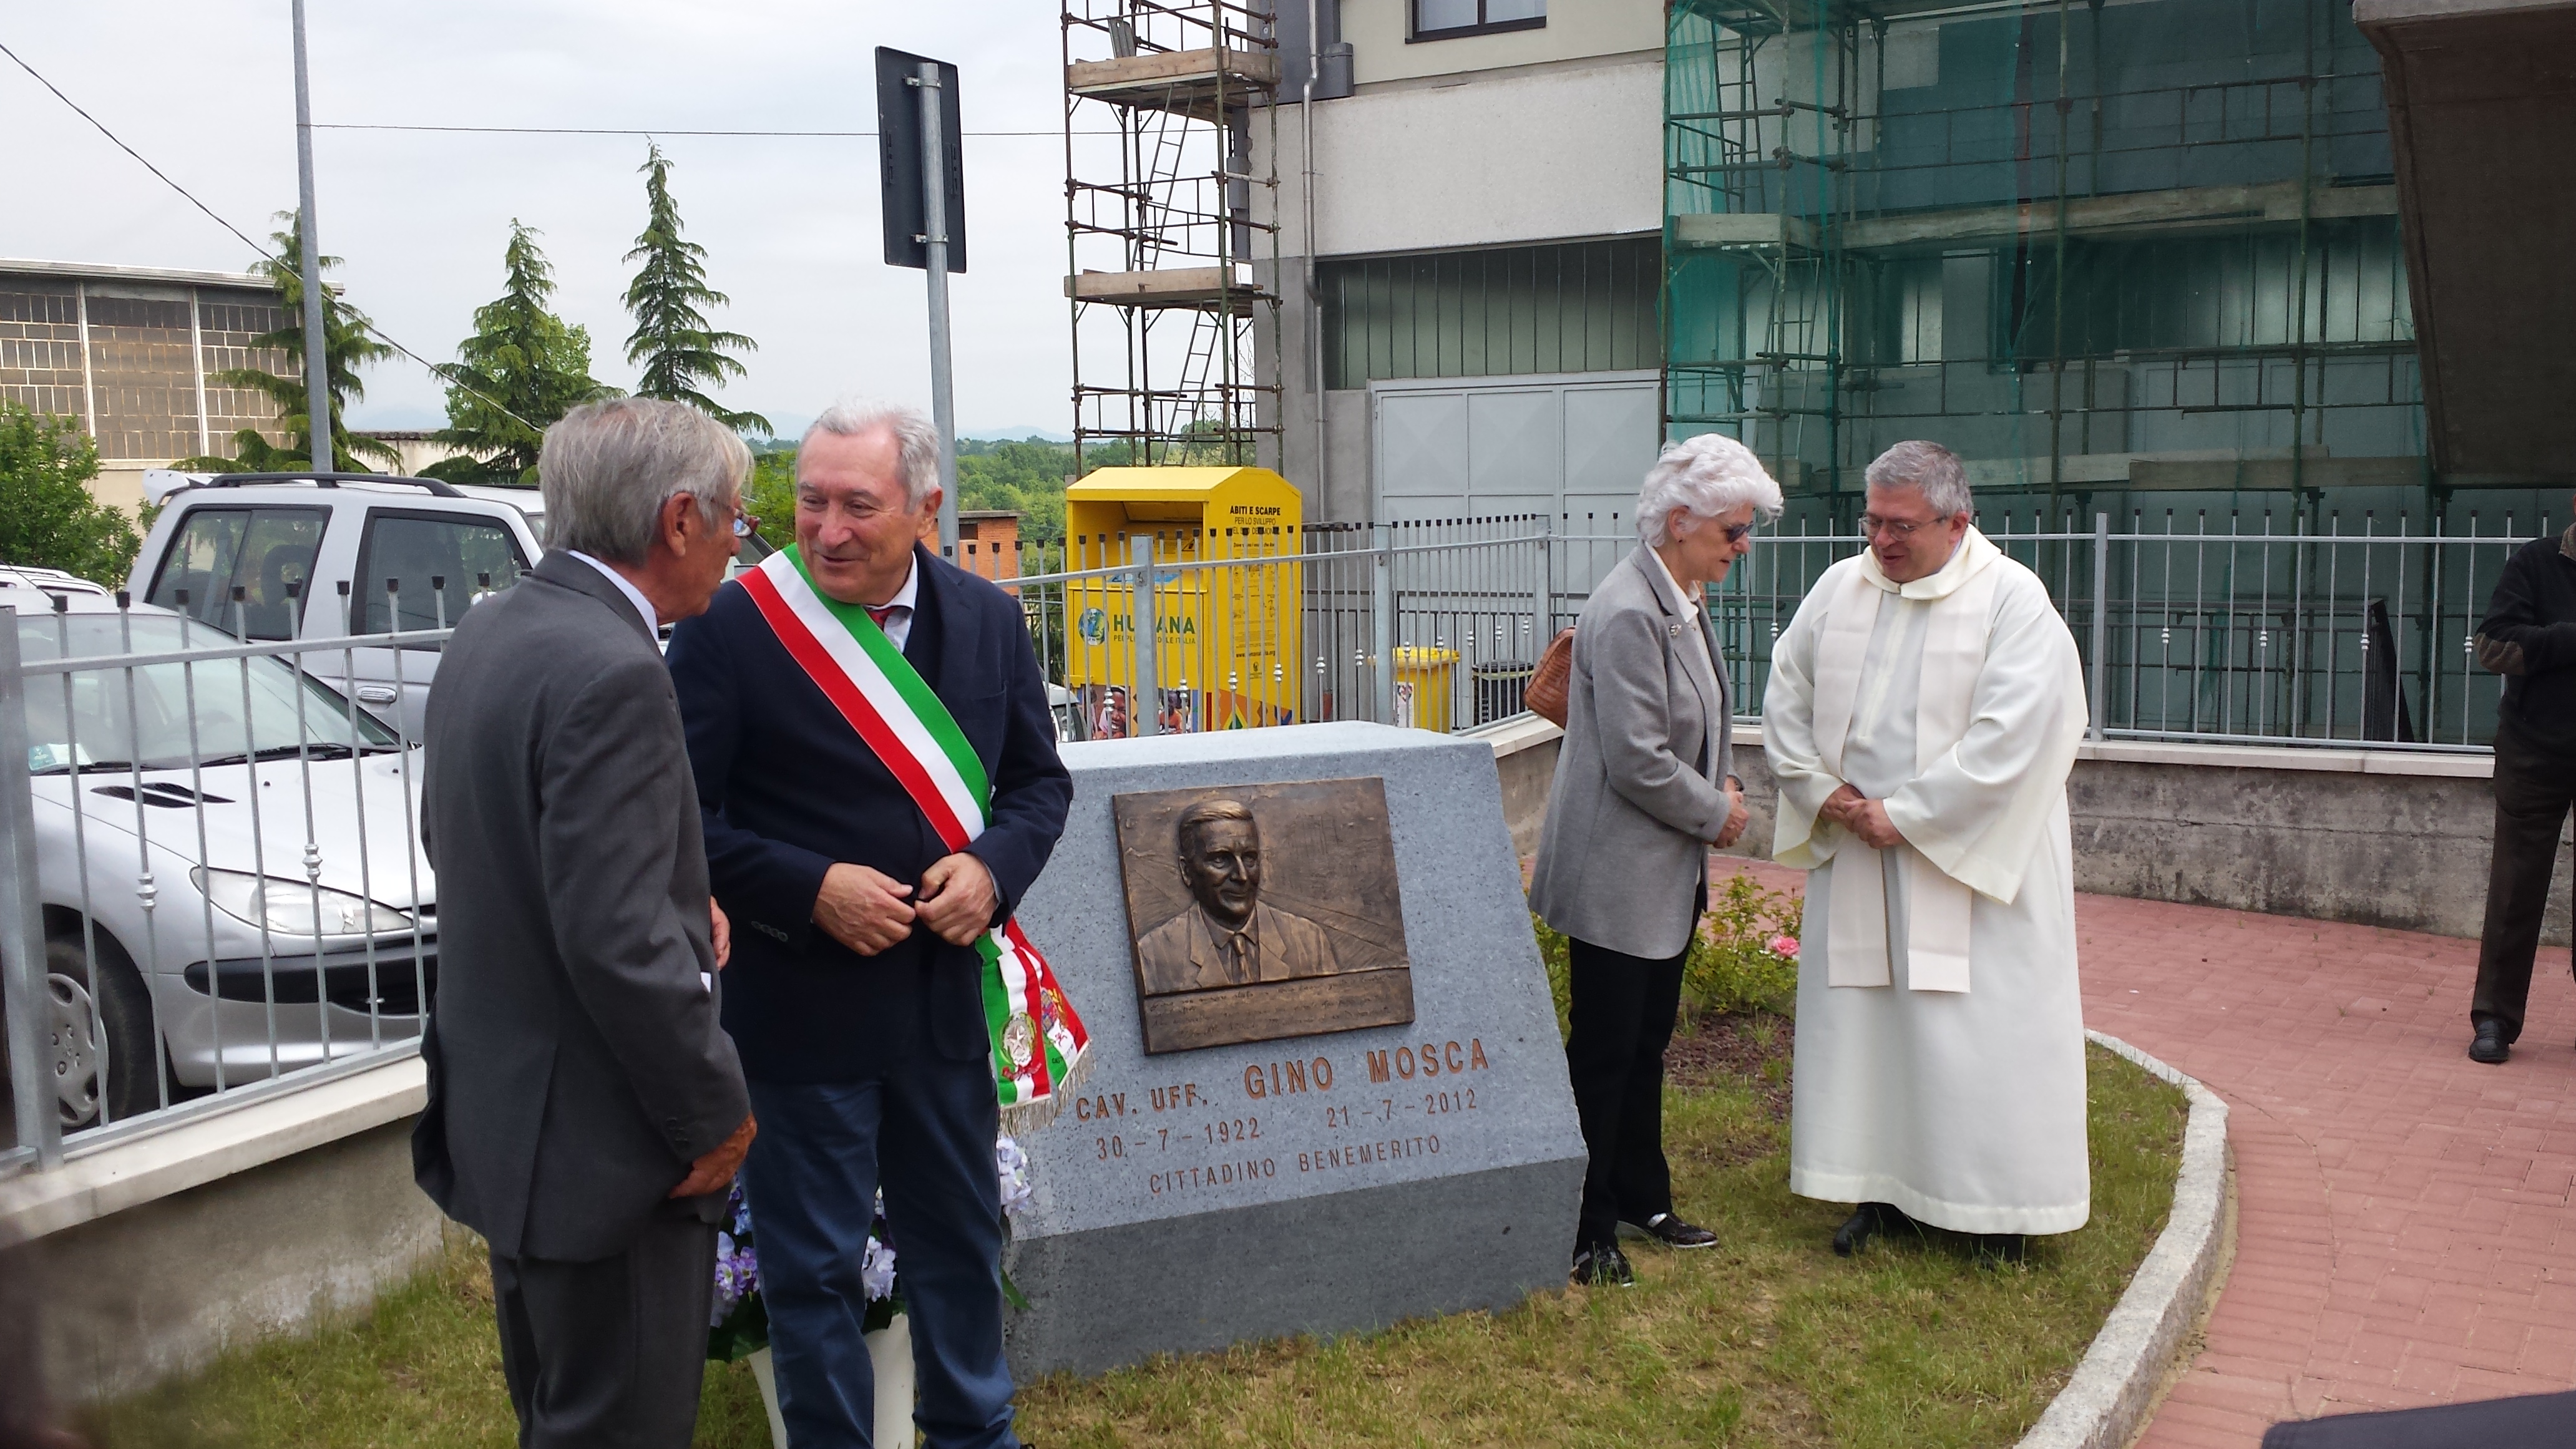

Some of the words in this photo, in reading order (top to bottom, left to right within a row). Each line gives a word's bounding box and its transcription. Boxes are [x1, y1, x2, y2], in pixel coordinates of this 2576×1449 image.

[1230, 505, 1247, 514] ABITI
[1249, 506, 1254, 515] E
[1256, 506, 1281, 515] SCARPE
[1114, 614, 1195, 634] HUANA
[1076, 1093, 1137, 1121] CAV.
[1151, 1083, 1208, 1113] UFF.
[1244, 1056, 1333, 1100] GINO
[1367, 1038, 1488, 1083] MOSCA
[1149, 1158, 1275, 1194] CITTADINO
[1299, 1135, 1440, 1172] BENEMERITO
